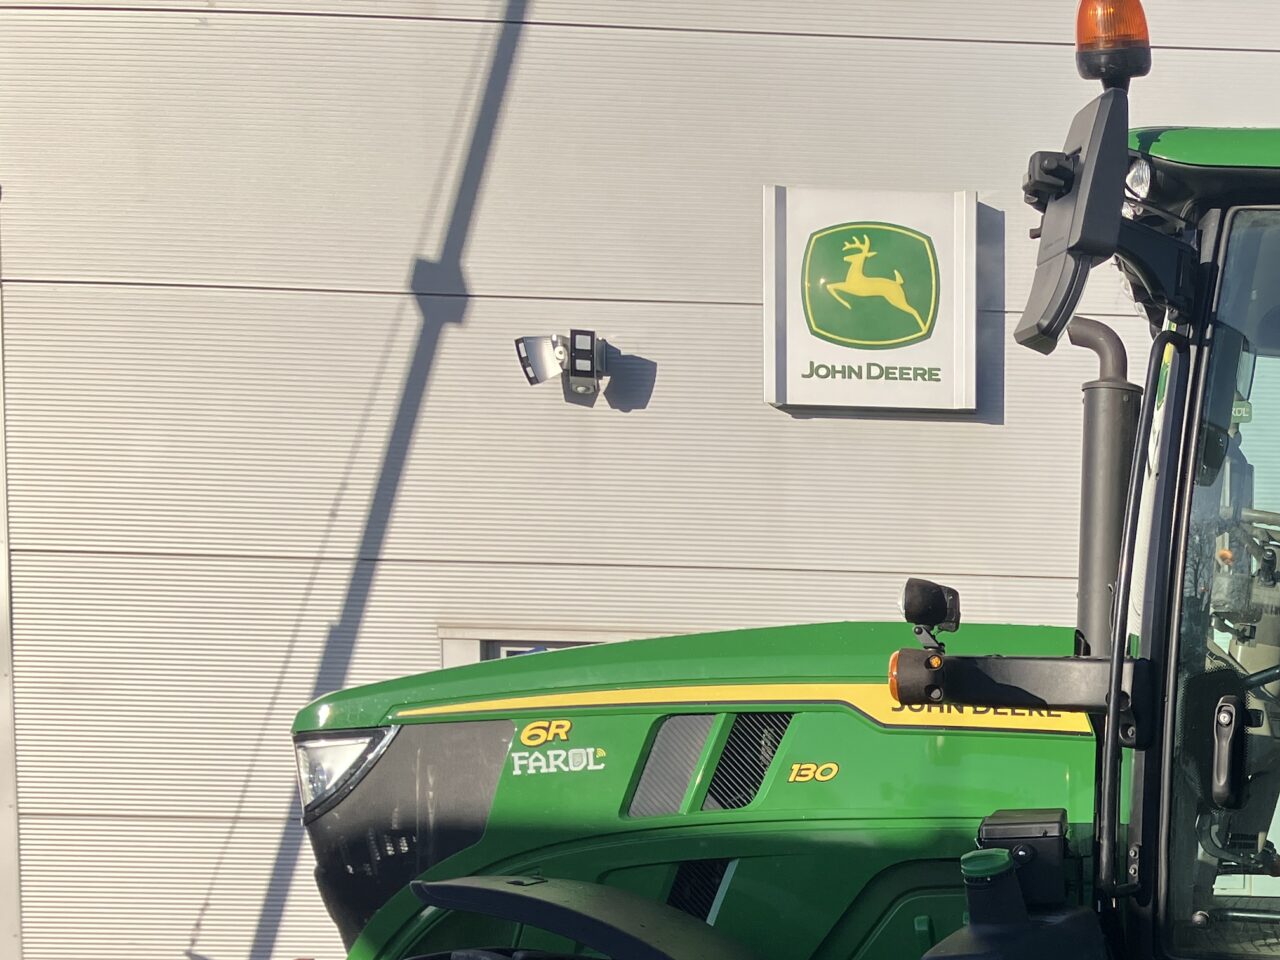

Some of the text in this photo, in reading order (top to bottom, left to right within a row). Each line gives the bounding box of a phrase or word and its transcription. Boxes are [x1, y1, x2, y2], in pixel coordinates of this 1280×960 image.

[801, 360, 942, 383] JOHN DEERE
[520, 719, 572, 747] 6R
[511, 748, 606, 776] FAROL
[787, 762, 840, 783] 130
